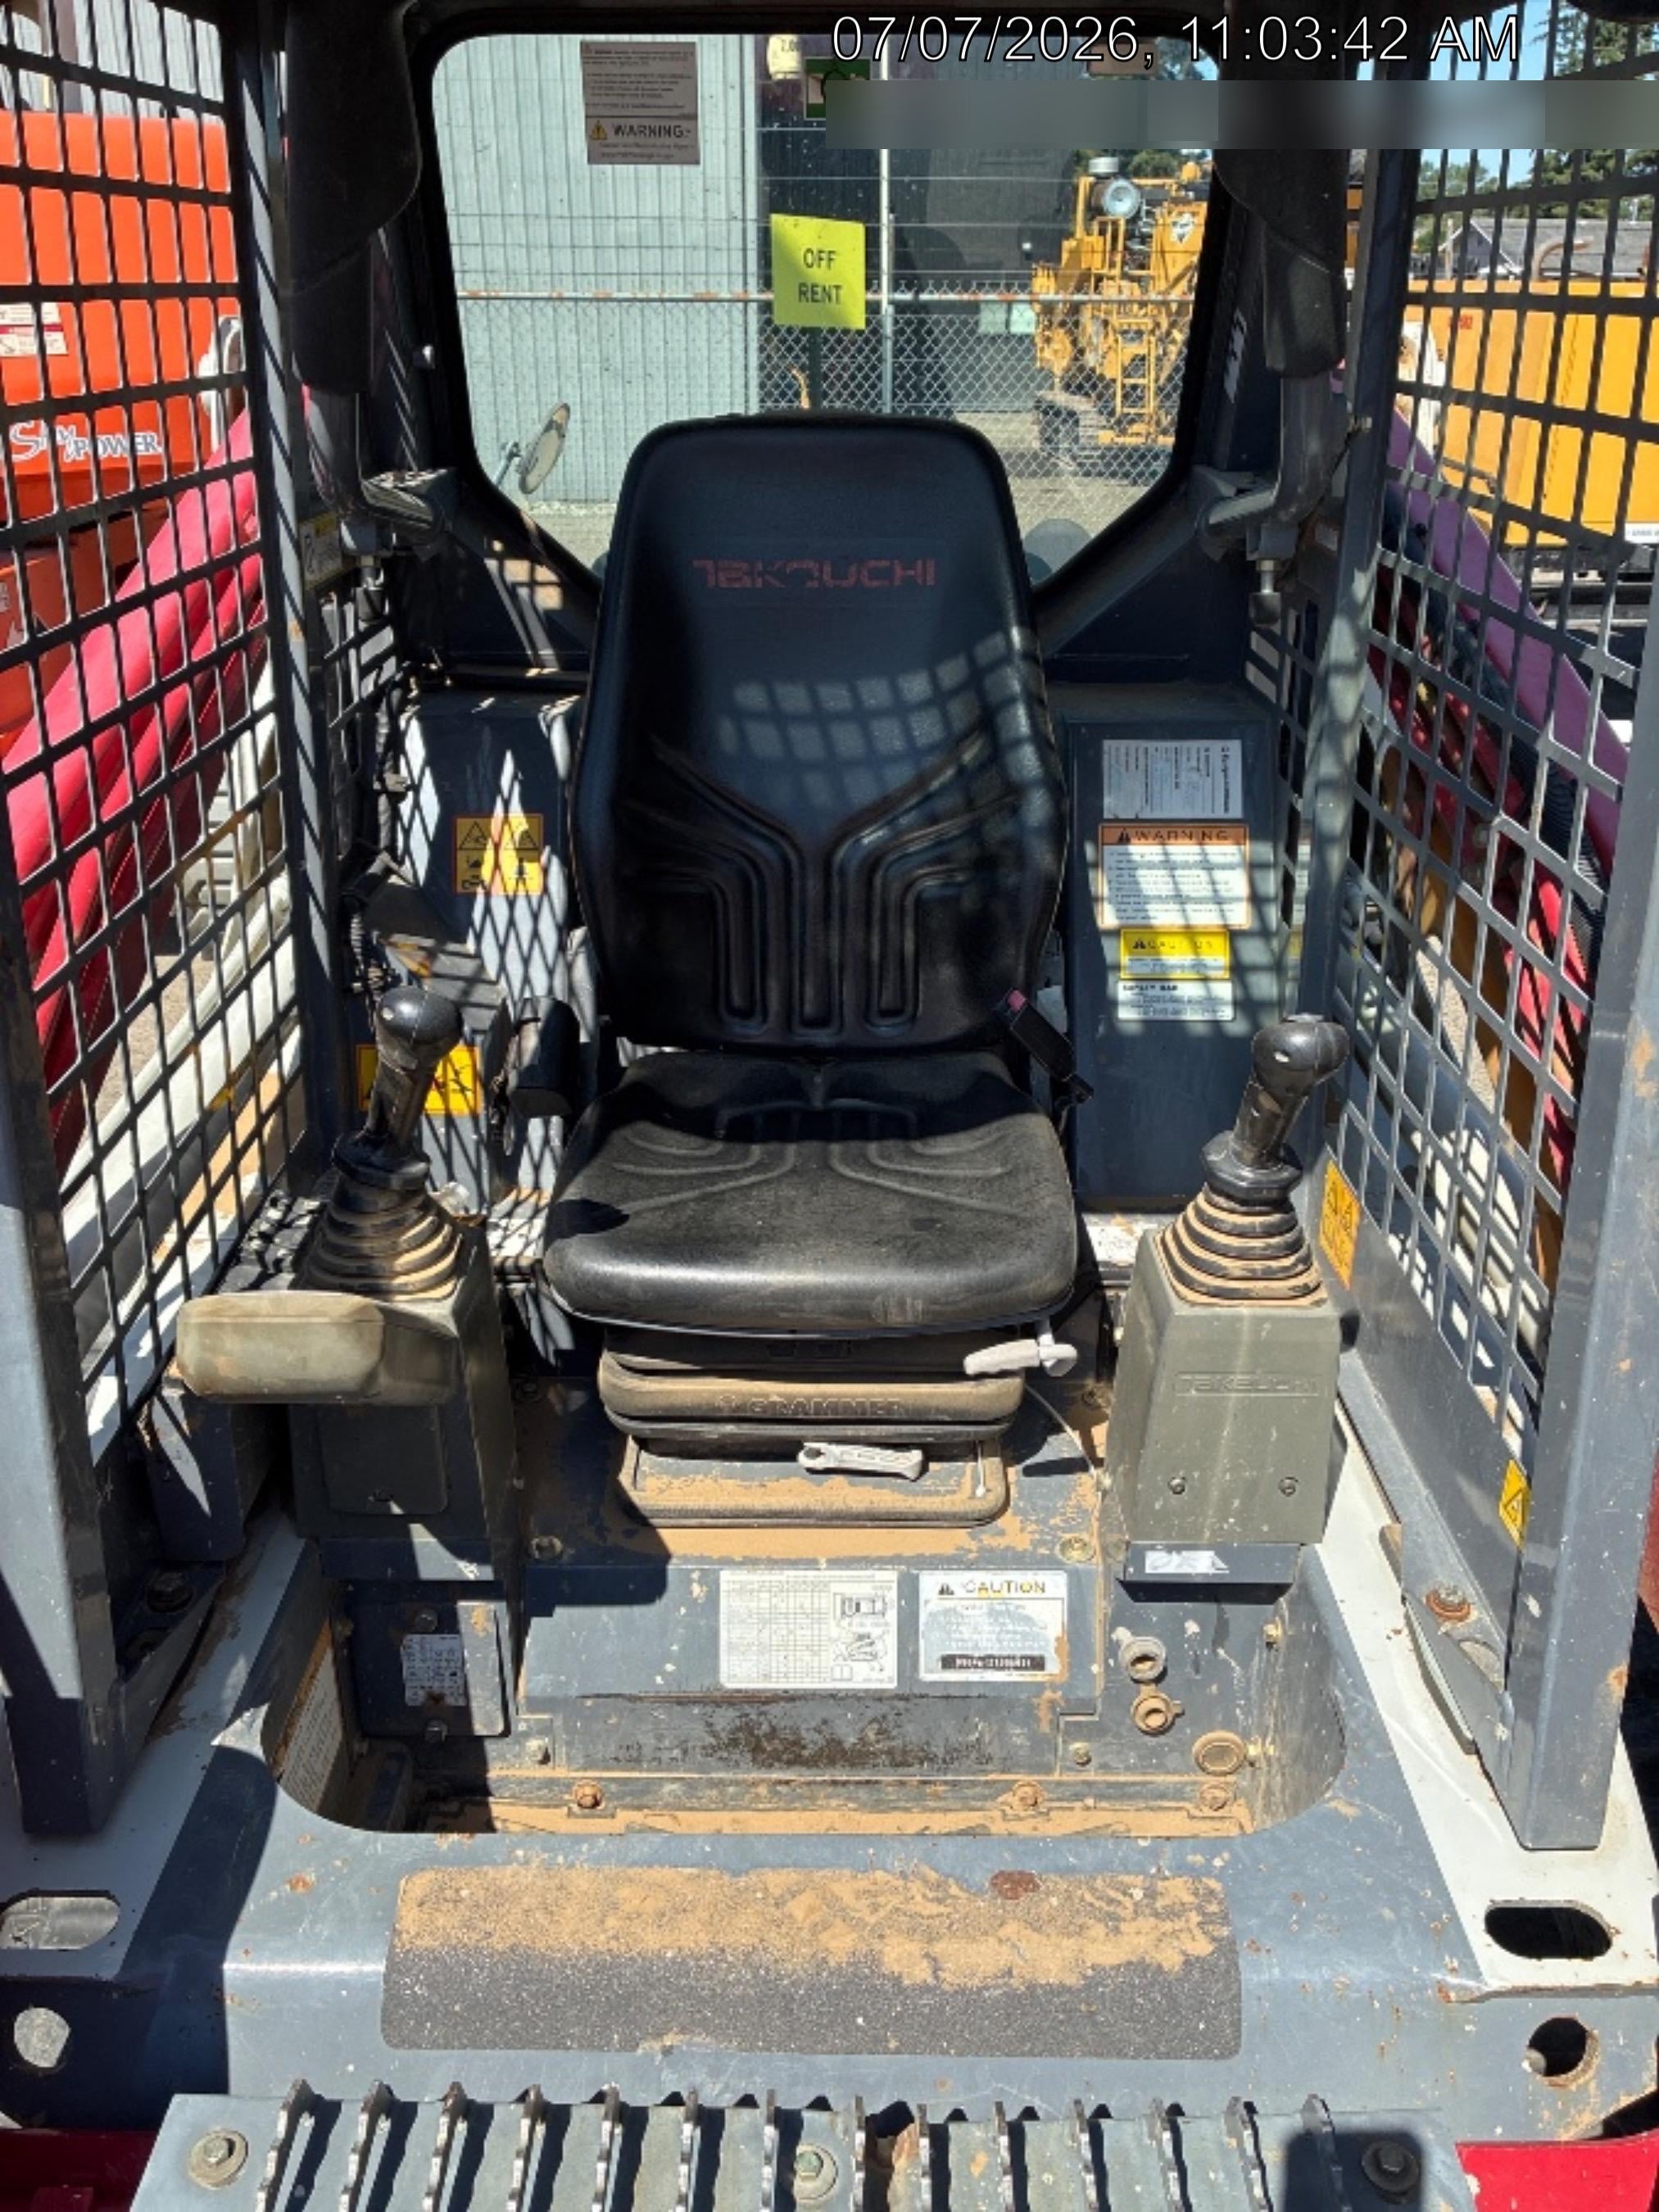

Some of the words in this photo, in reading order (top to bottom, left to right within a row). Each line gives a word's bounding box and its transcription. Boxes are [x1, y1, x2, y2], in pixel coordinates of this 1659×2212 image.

[804, 248, 836, 270] OFF
[798, 283, 842, 304] RENT
[1148, 940, 1213, 950] CAUON
[963, 1579, 1046, 1594] CAUTION
